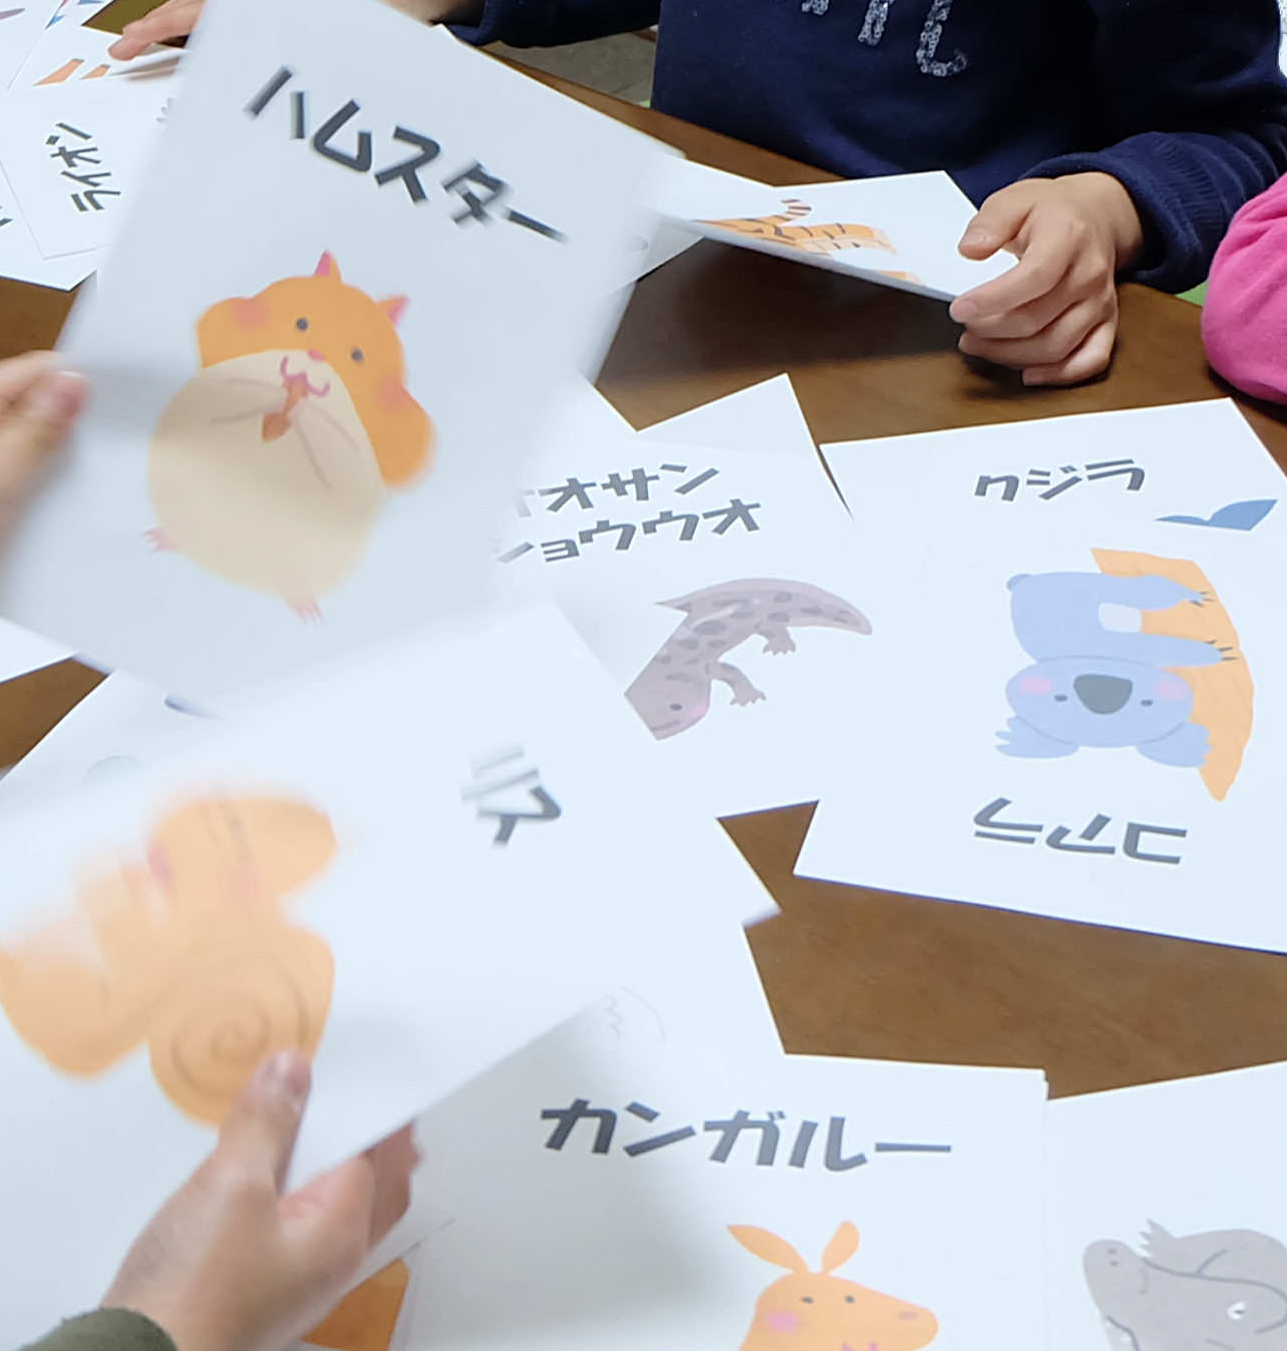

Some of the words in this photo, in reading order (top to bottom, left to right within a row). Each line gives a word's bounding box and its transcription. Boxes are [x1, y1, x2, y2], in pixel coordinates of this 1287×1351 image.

[46, 122, 121, 212] ライオン
[243, 65, 571, 243] ハムスター
[974, 459, 1145, 502] クジラ
[460, 742, 562, 849] リス
[974, 797, 1187, 865] コアラ
[541, 1099, 952, 1172] カンガルー
